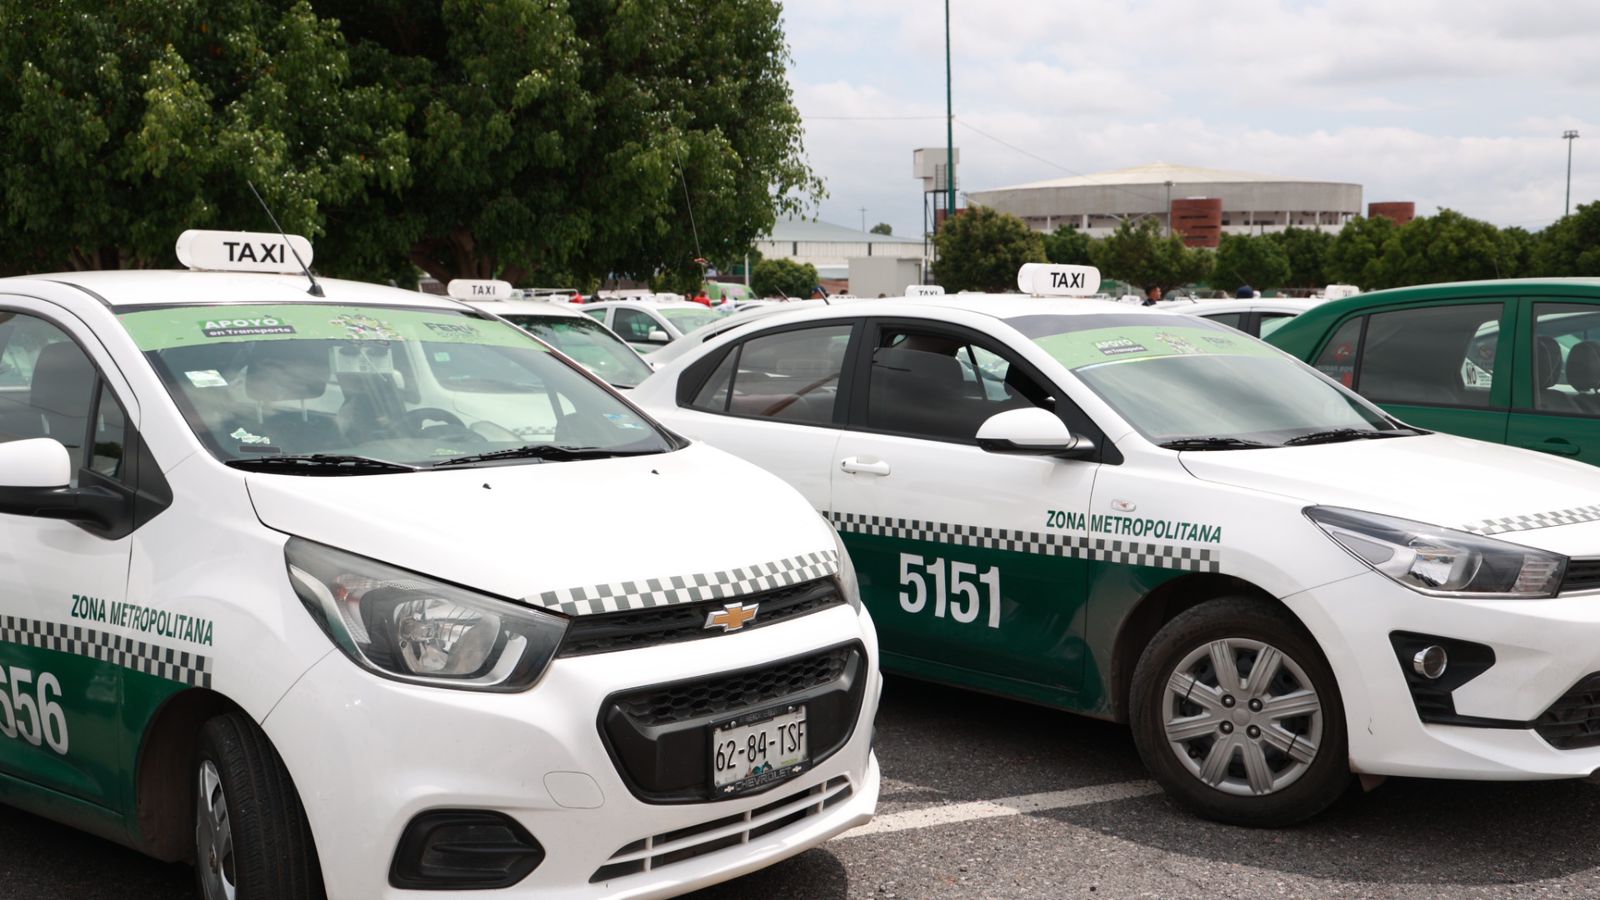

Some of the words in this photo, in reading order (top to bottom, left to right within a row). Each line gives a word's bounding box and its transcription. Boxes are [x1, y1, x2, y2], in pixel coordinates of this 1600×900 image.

[223, 242, 285, 263] TAXI
[471, 284, 496, 296] TAXI
[1050, 272, 1085, 289] TAXI
[205, 318, 279, 330] APOYO
[1046, 510, 1086, 531] ZONA
[1090, 515, 1222, 543] METROPOLITANA
[899, 552, 1000, 628] 5151
[71, 594, 106, 622] ZONA
[109, 601, 213, 646] METROPOLITANA
[716, 719, 806, 772] 62-84-TSF
[735, 766, 792, 791] CHEVROLET
